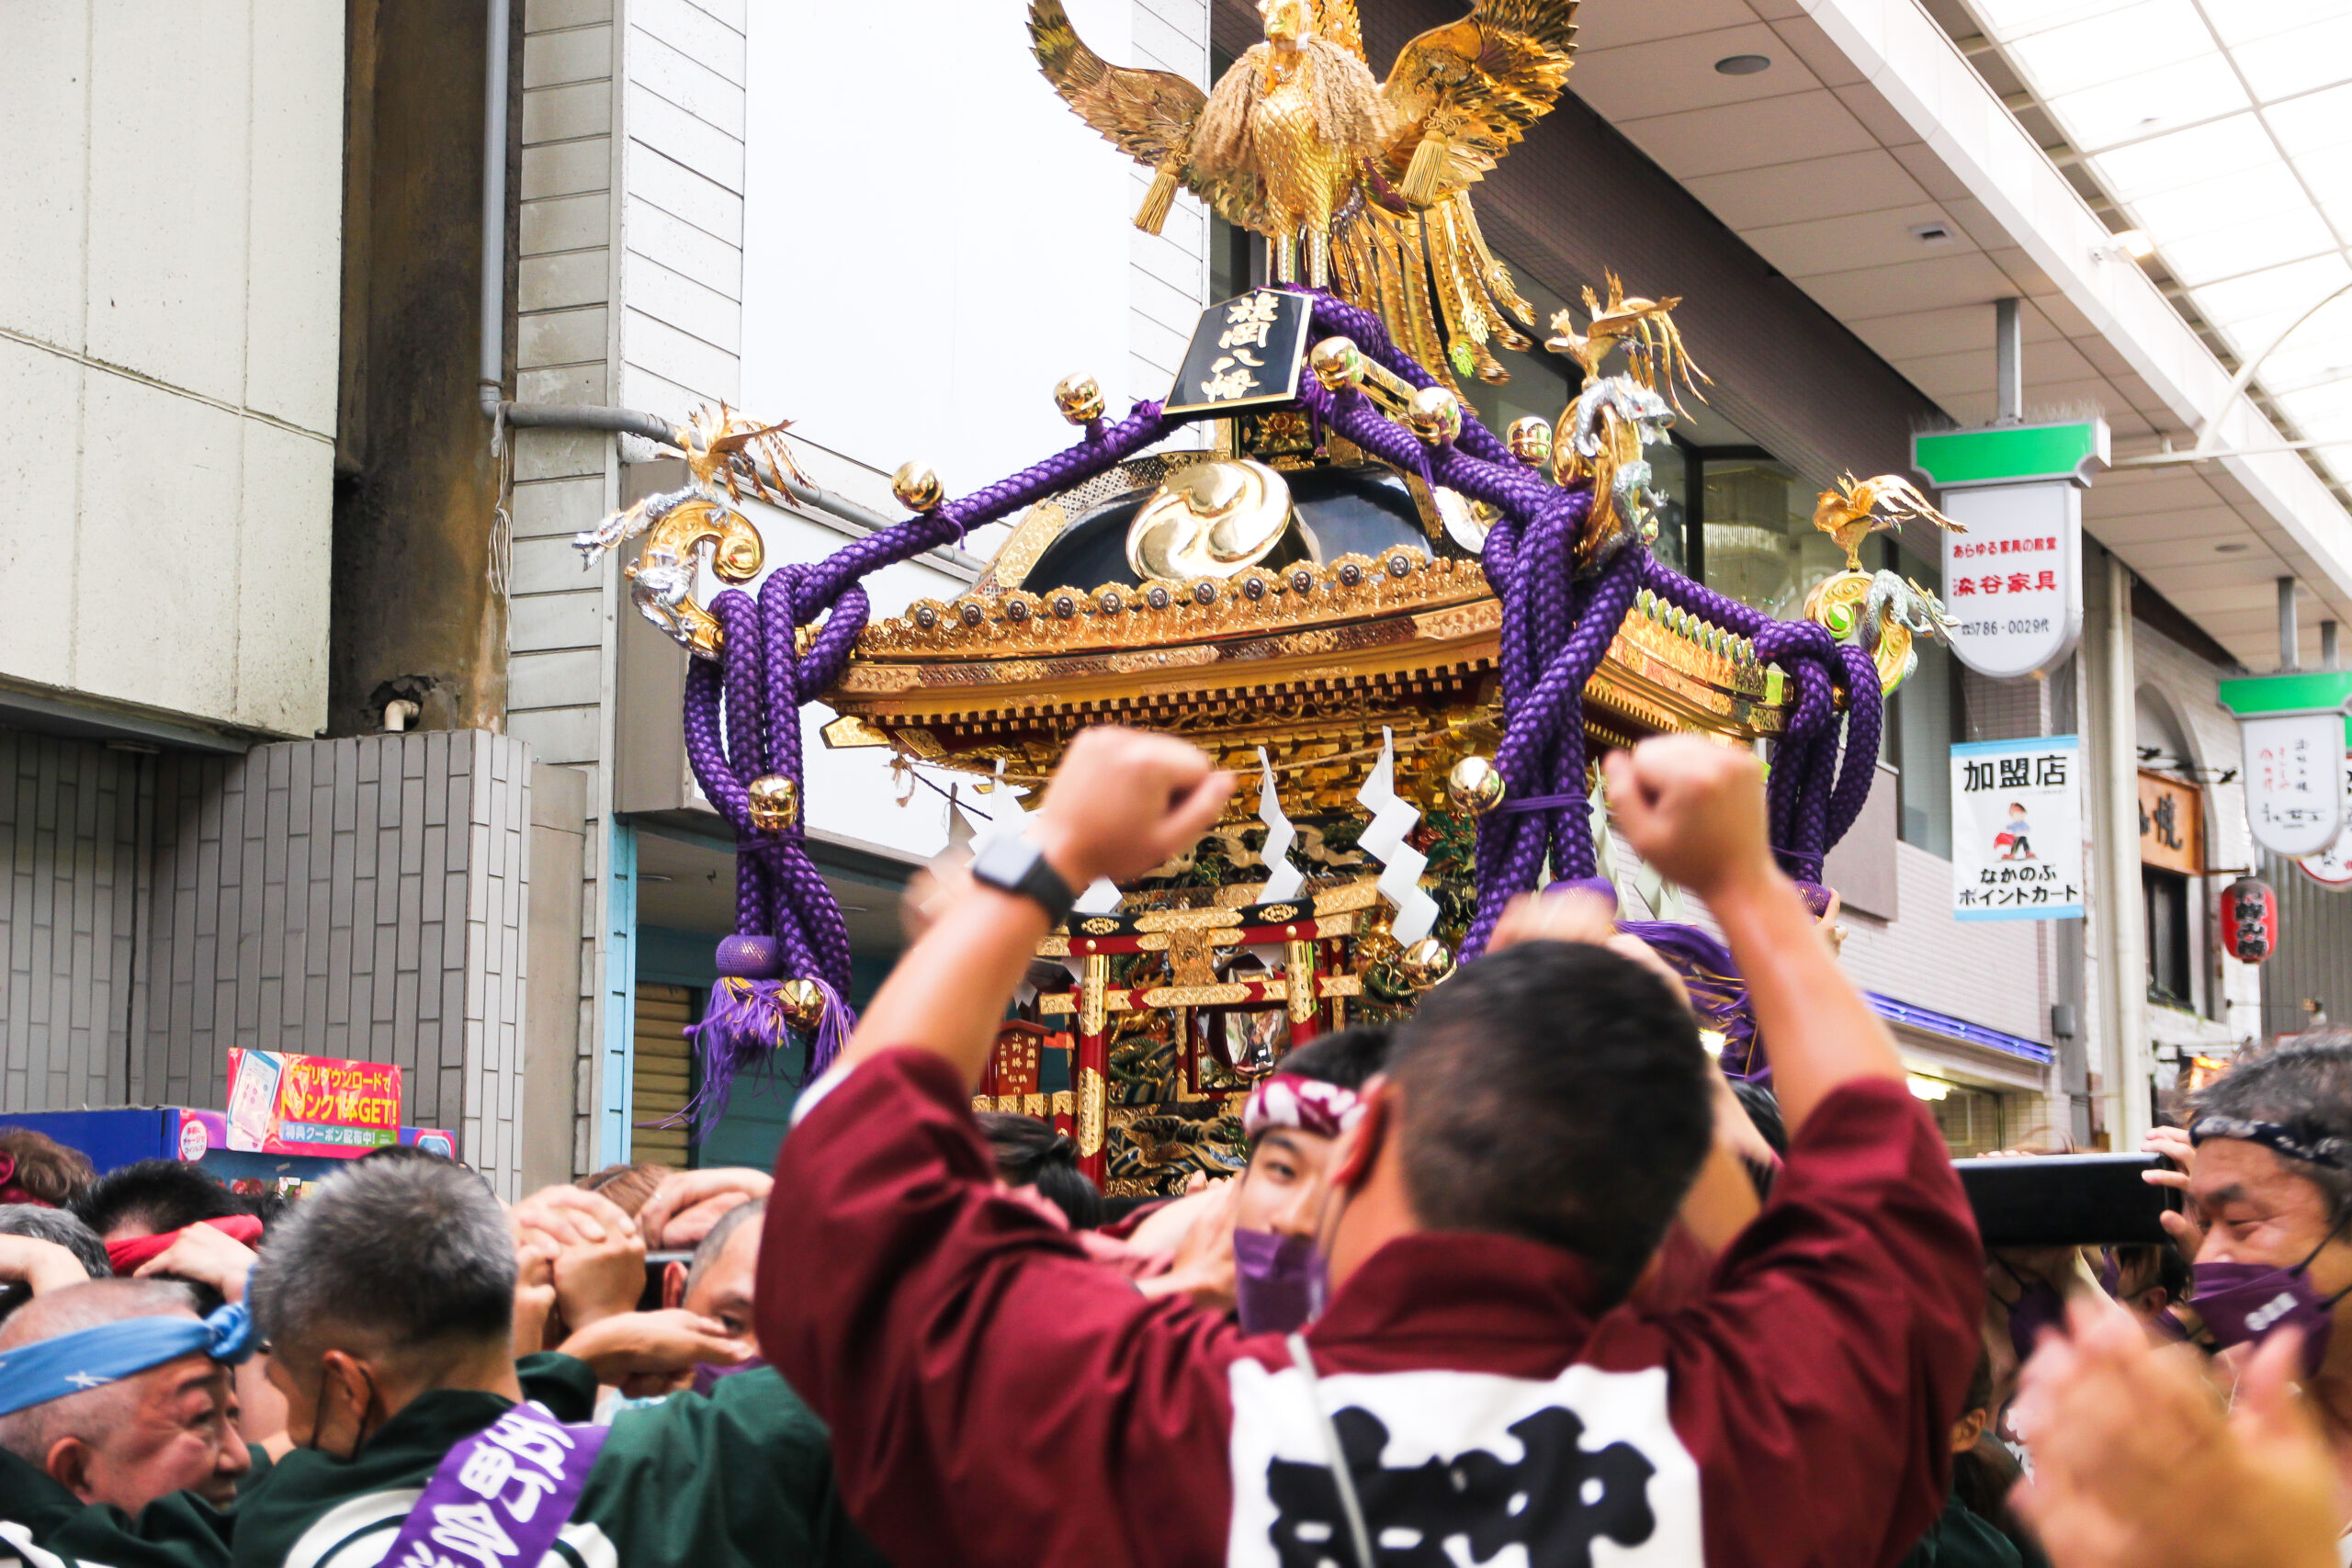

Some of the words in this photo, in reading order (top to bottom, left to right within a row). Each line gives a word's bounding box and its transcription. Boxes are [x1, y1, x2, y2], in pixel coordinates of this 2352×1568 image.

[1202, 292, 1279, 403] 旗岡八幡
[1952, 570, 2058, 596] 染谷家具
[1963, 755, 2068, 792] 加盟店
[1980, 864, 2057, 885] なかのぶ
[1959, 884, 2080, 907] ポイントカード
